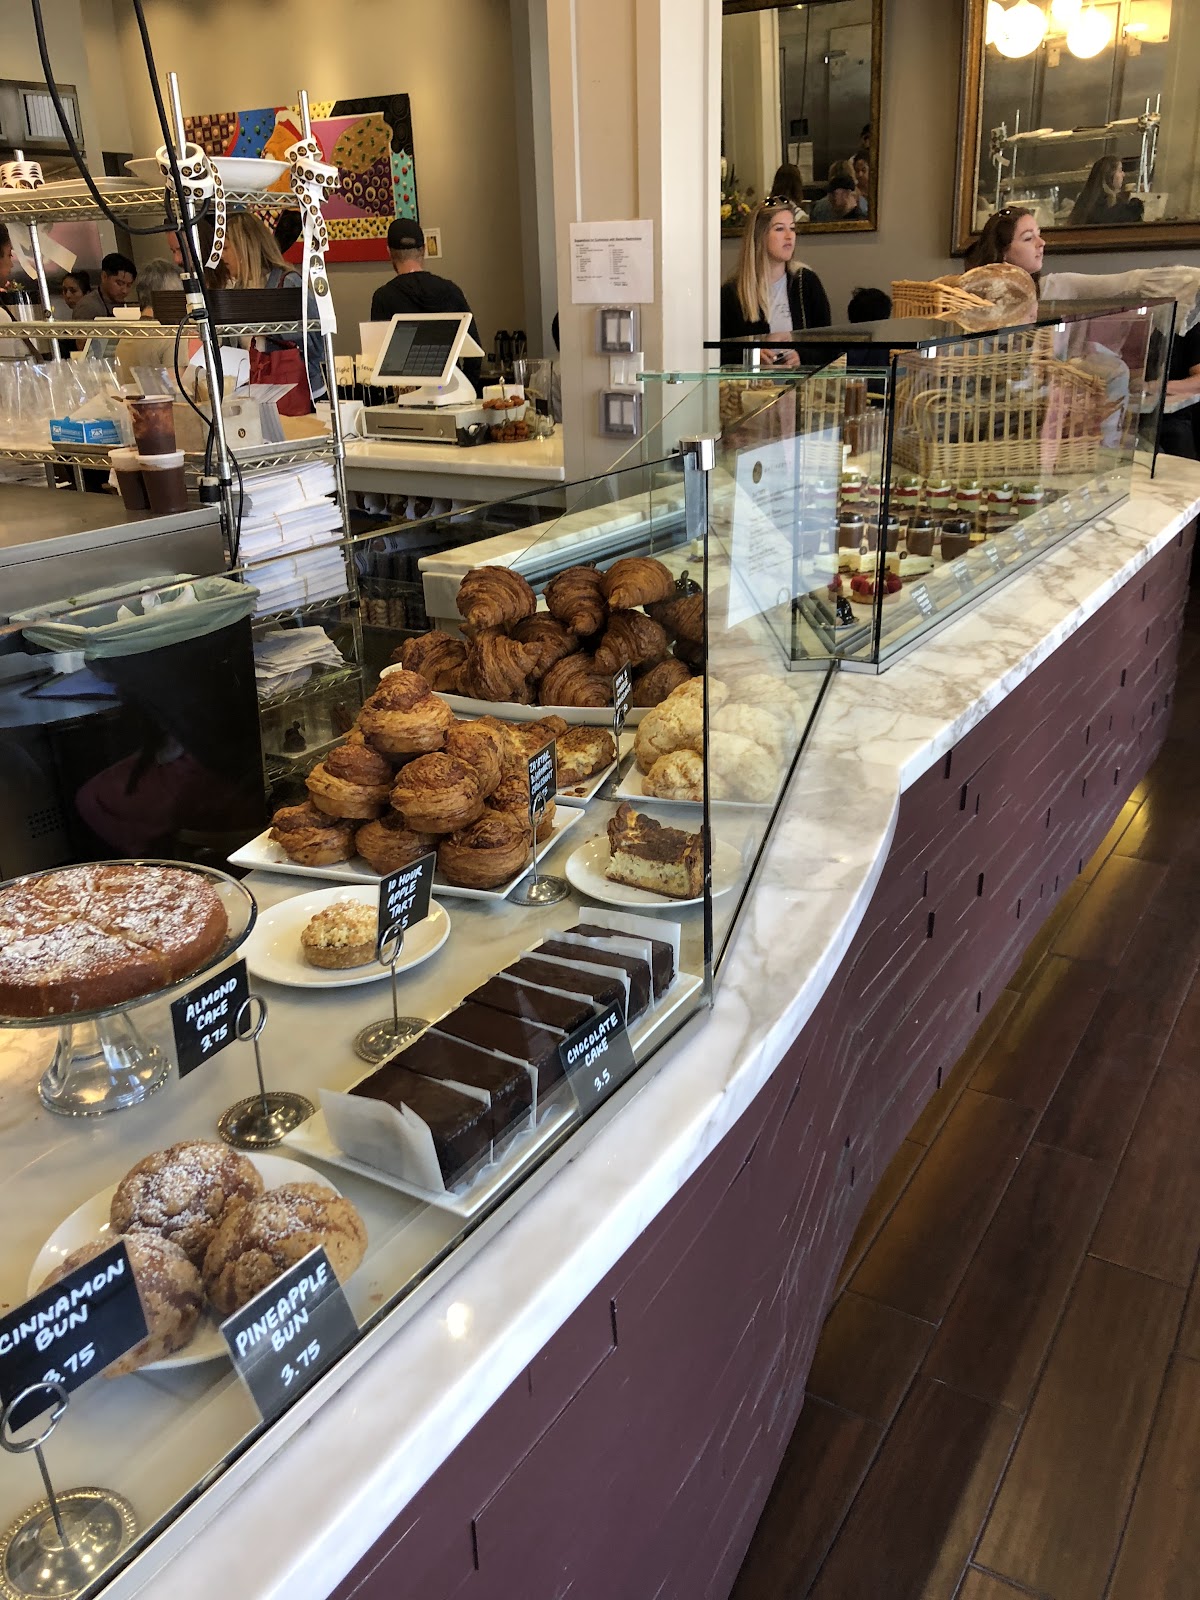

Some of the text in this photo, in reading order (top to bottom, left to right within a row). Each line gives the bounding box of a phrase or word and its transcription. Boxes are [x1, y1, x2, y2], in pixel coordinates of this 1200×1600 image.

[387, 879, 417, 908] APPLE
[398, 864, 423, 887] HOUR
[389, 894, 416, 919] TART
[185, 977, 238, 1023] ALMOND
[196, 998, 229, 1031] CAKE
[200, 1023, 229, 1053] 3.75
[567, 1012, 618, 1064] CHOCOLATE
[584, 1036, 609, 1067] CAKE
[594, 1067, 611, 1092] 3.5
[0, 1258, 125, 1356] CINNAMON
[235, 1261, 328, 1357] PINEAPPLE
[34, 1303, 89, 1352] BUN
[271, 1307, 309, 1352] BUN
[281, 1338, 321, 1387] 3.75
